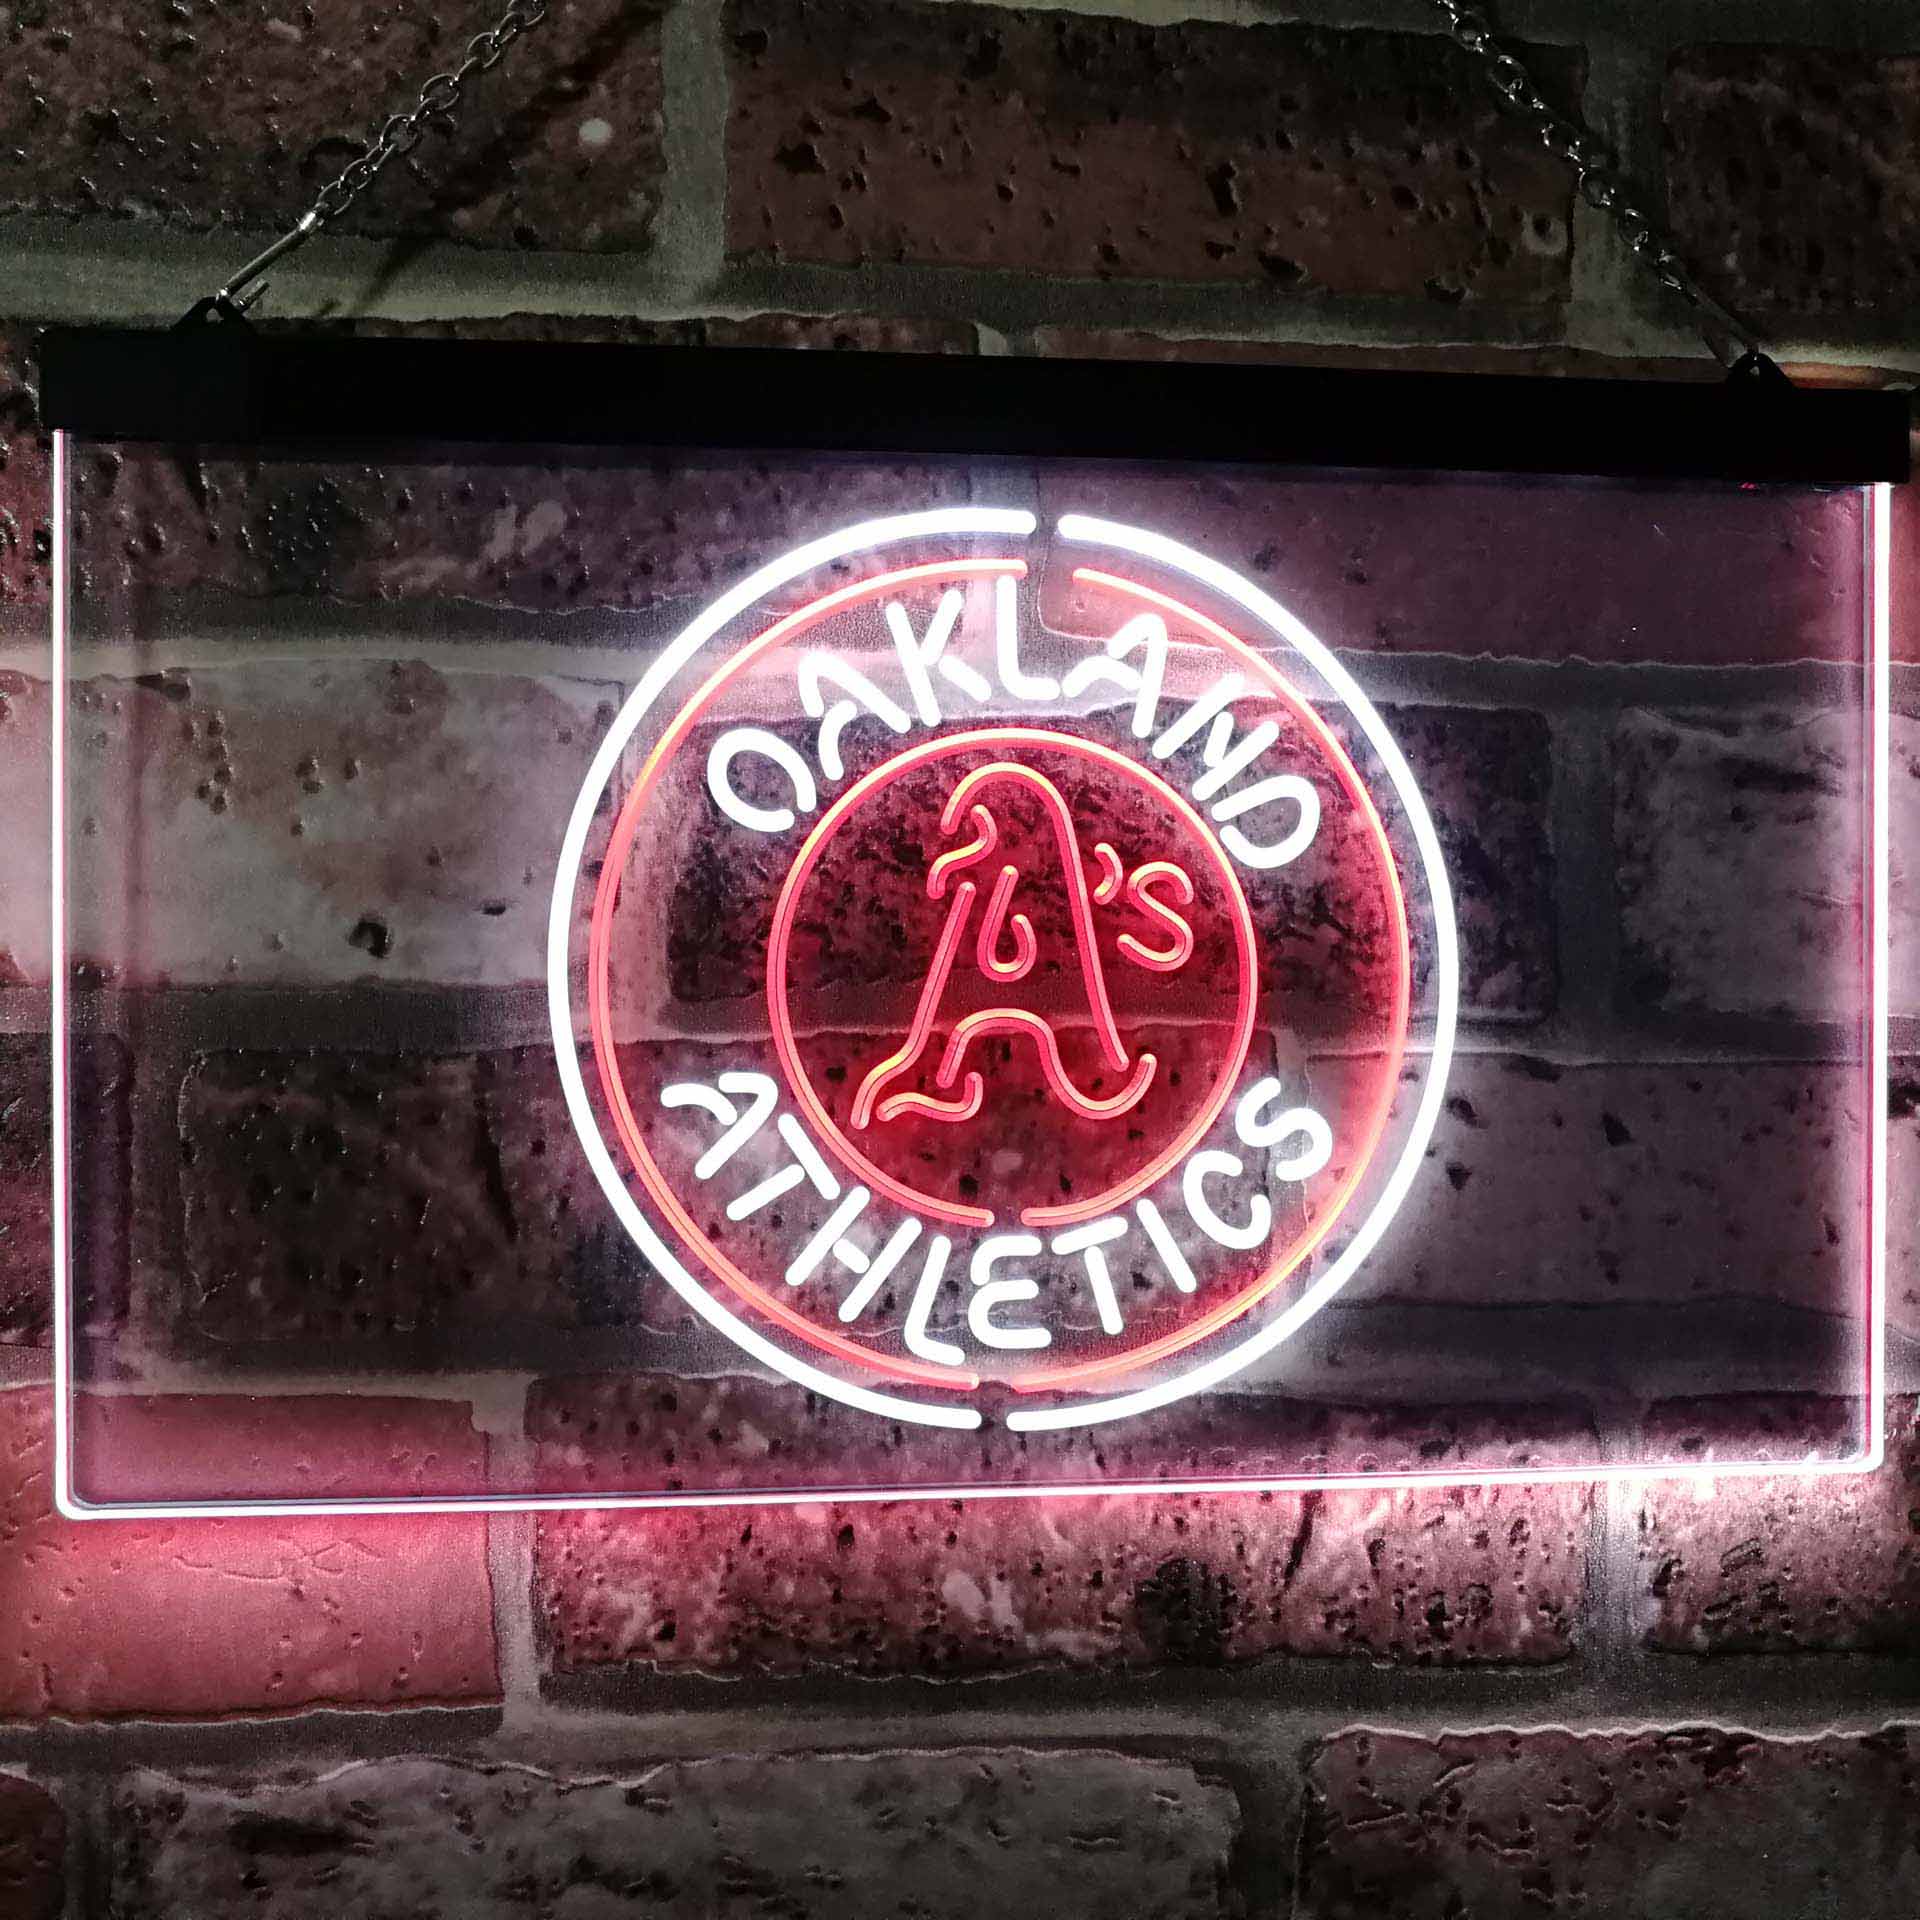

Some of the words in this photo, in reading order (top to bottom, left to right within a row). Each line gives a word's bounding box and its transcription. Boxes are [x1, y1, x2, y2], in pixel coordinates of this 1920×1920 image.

[707, 575, 1321, 869] OAKLAND
[852, 762, 1194, 1130] A's
[661, 1072, 1332, 1363] ATHLETICS
